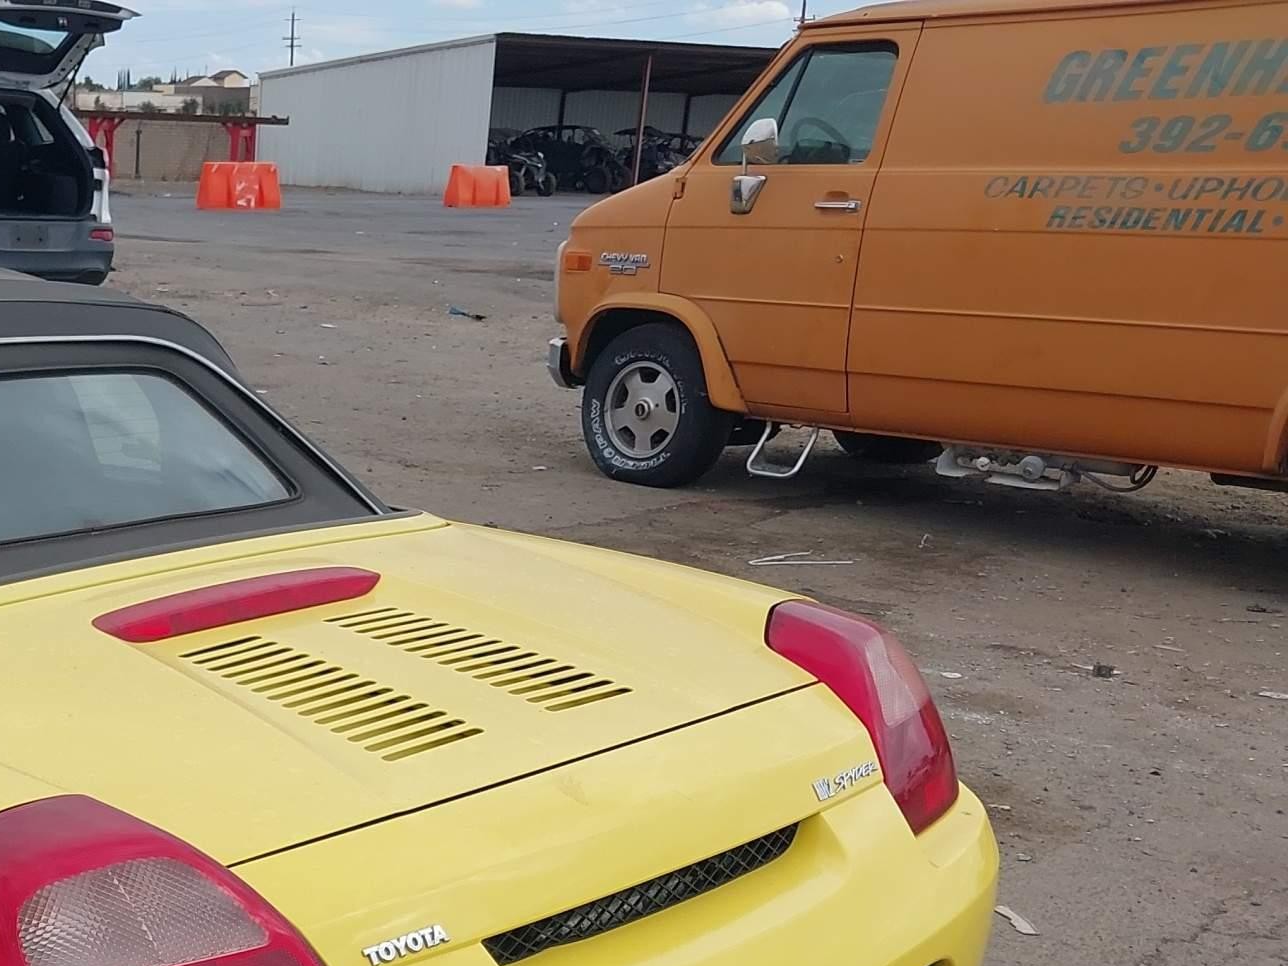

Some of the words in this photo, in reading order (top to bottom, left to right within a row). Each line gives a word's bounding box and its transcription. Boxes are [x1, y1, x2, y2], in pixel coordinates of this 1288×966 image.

[1044, 37, 1288, 104] GREENH
[1117, 111, 1288, 155] 392-6
[983, 175, 1149, 200] CARPETS
[1167, 176, 1288, 202] UPHO
[1045, 204, 1268, 234] RESIDENTIAL
[833, 760, 879, 793] SPYDER
